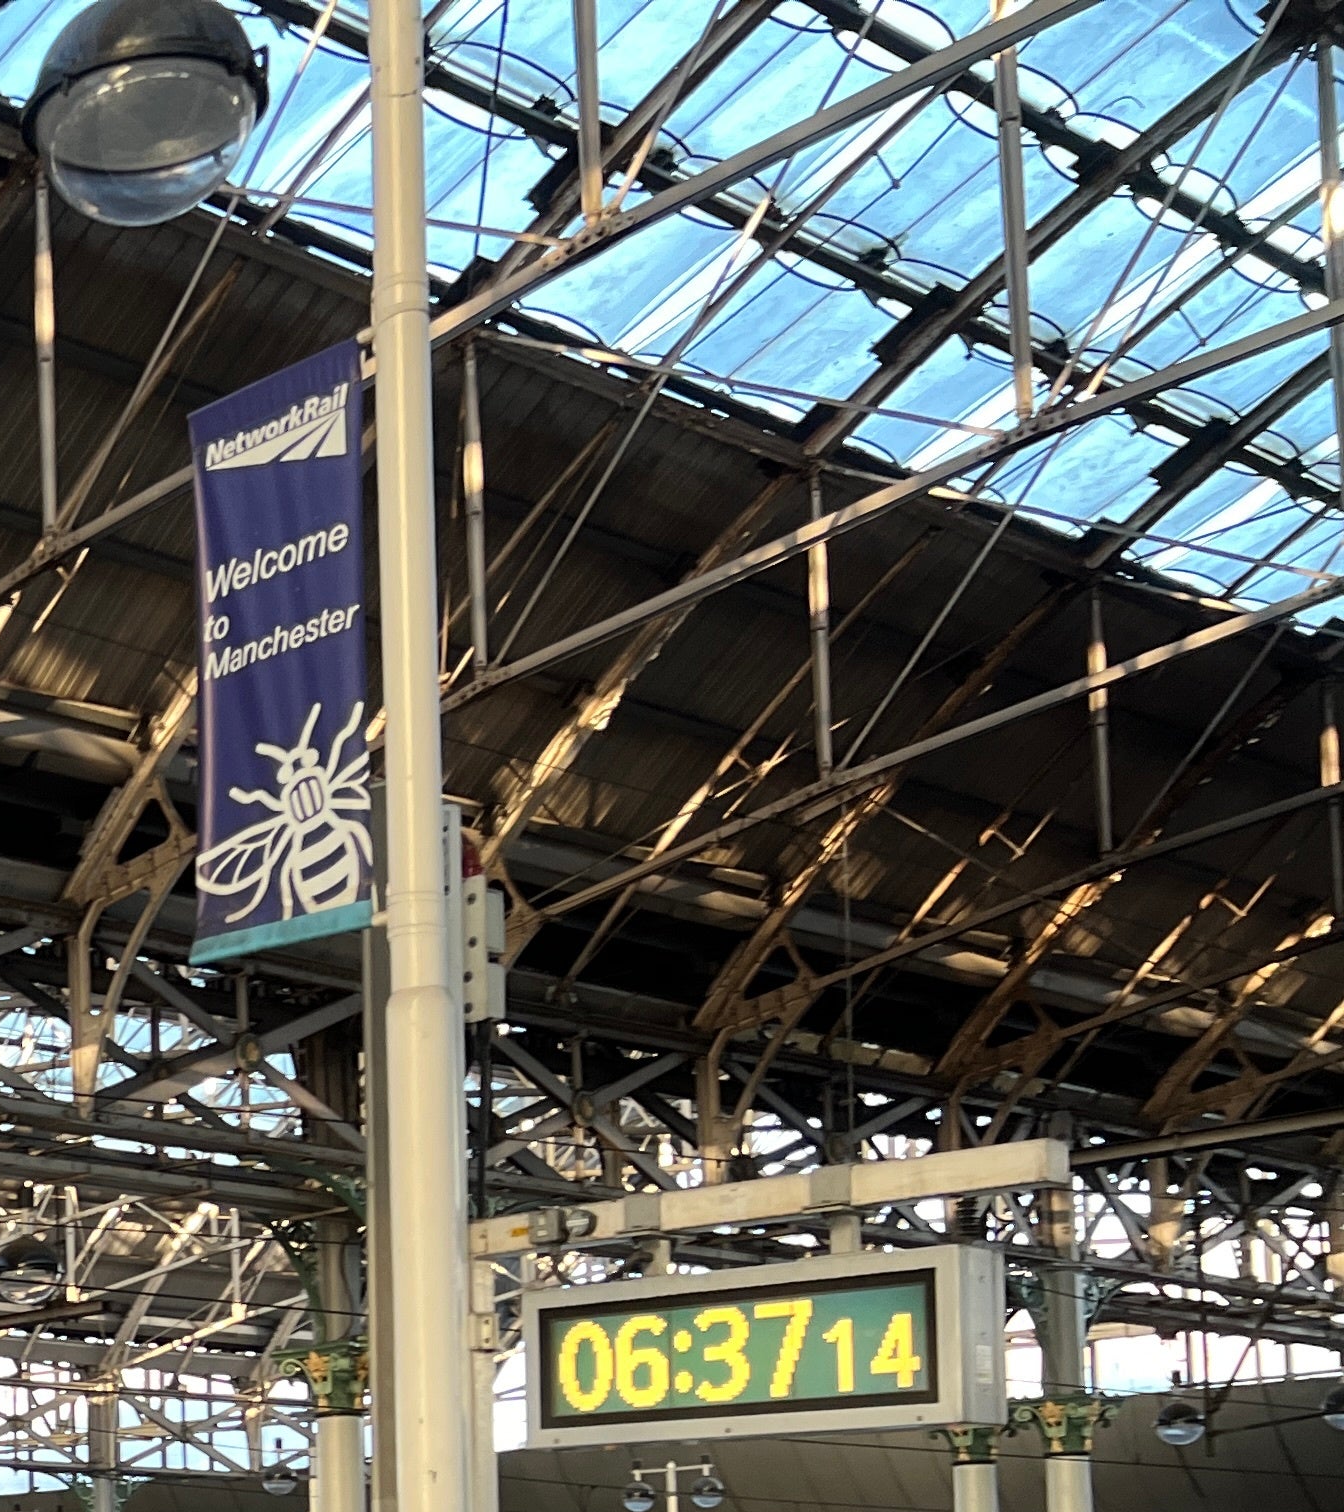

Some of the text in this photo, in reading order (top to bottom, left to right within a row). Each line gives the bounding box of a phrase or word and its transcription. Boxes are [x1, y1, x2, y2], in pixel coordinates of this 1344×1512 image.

[206, 523, 350, 603] Welcome
[203, 615, 229, 642] to
[204, 604, 360, 681] Manchester
[559, 1300, 921, 1412] 06:37 14
